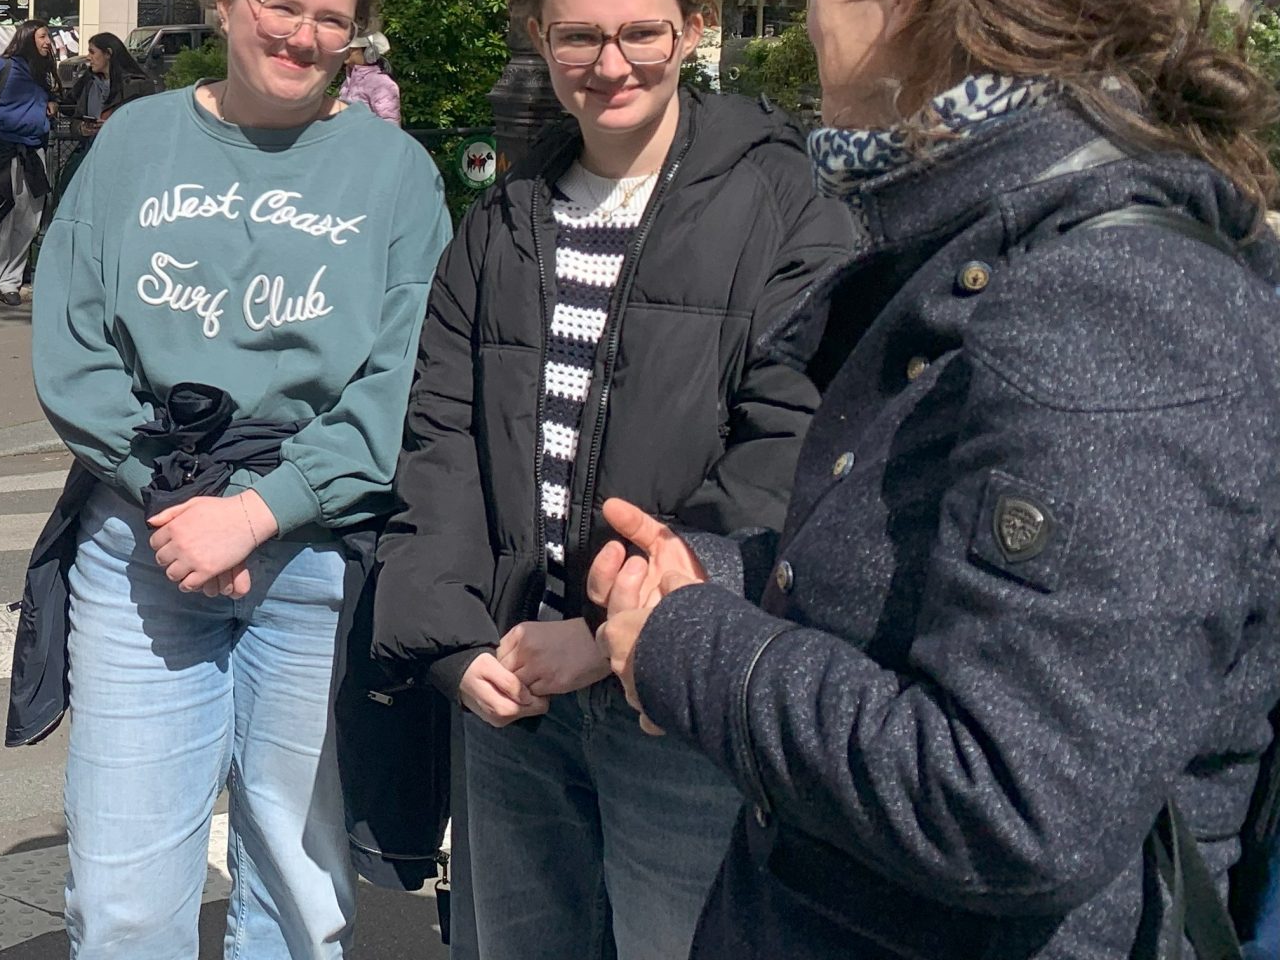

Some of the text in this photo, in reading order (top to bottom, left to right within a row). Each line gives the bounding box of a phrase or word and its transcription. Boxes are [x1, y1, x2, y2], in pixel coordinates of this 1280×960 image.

[139, 182, 367, 244] West Coast
[137, 251, 334, 338] Surf Club
